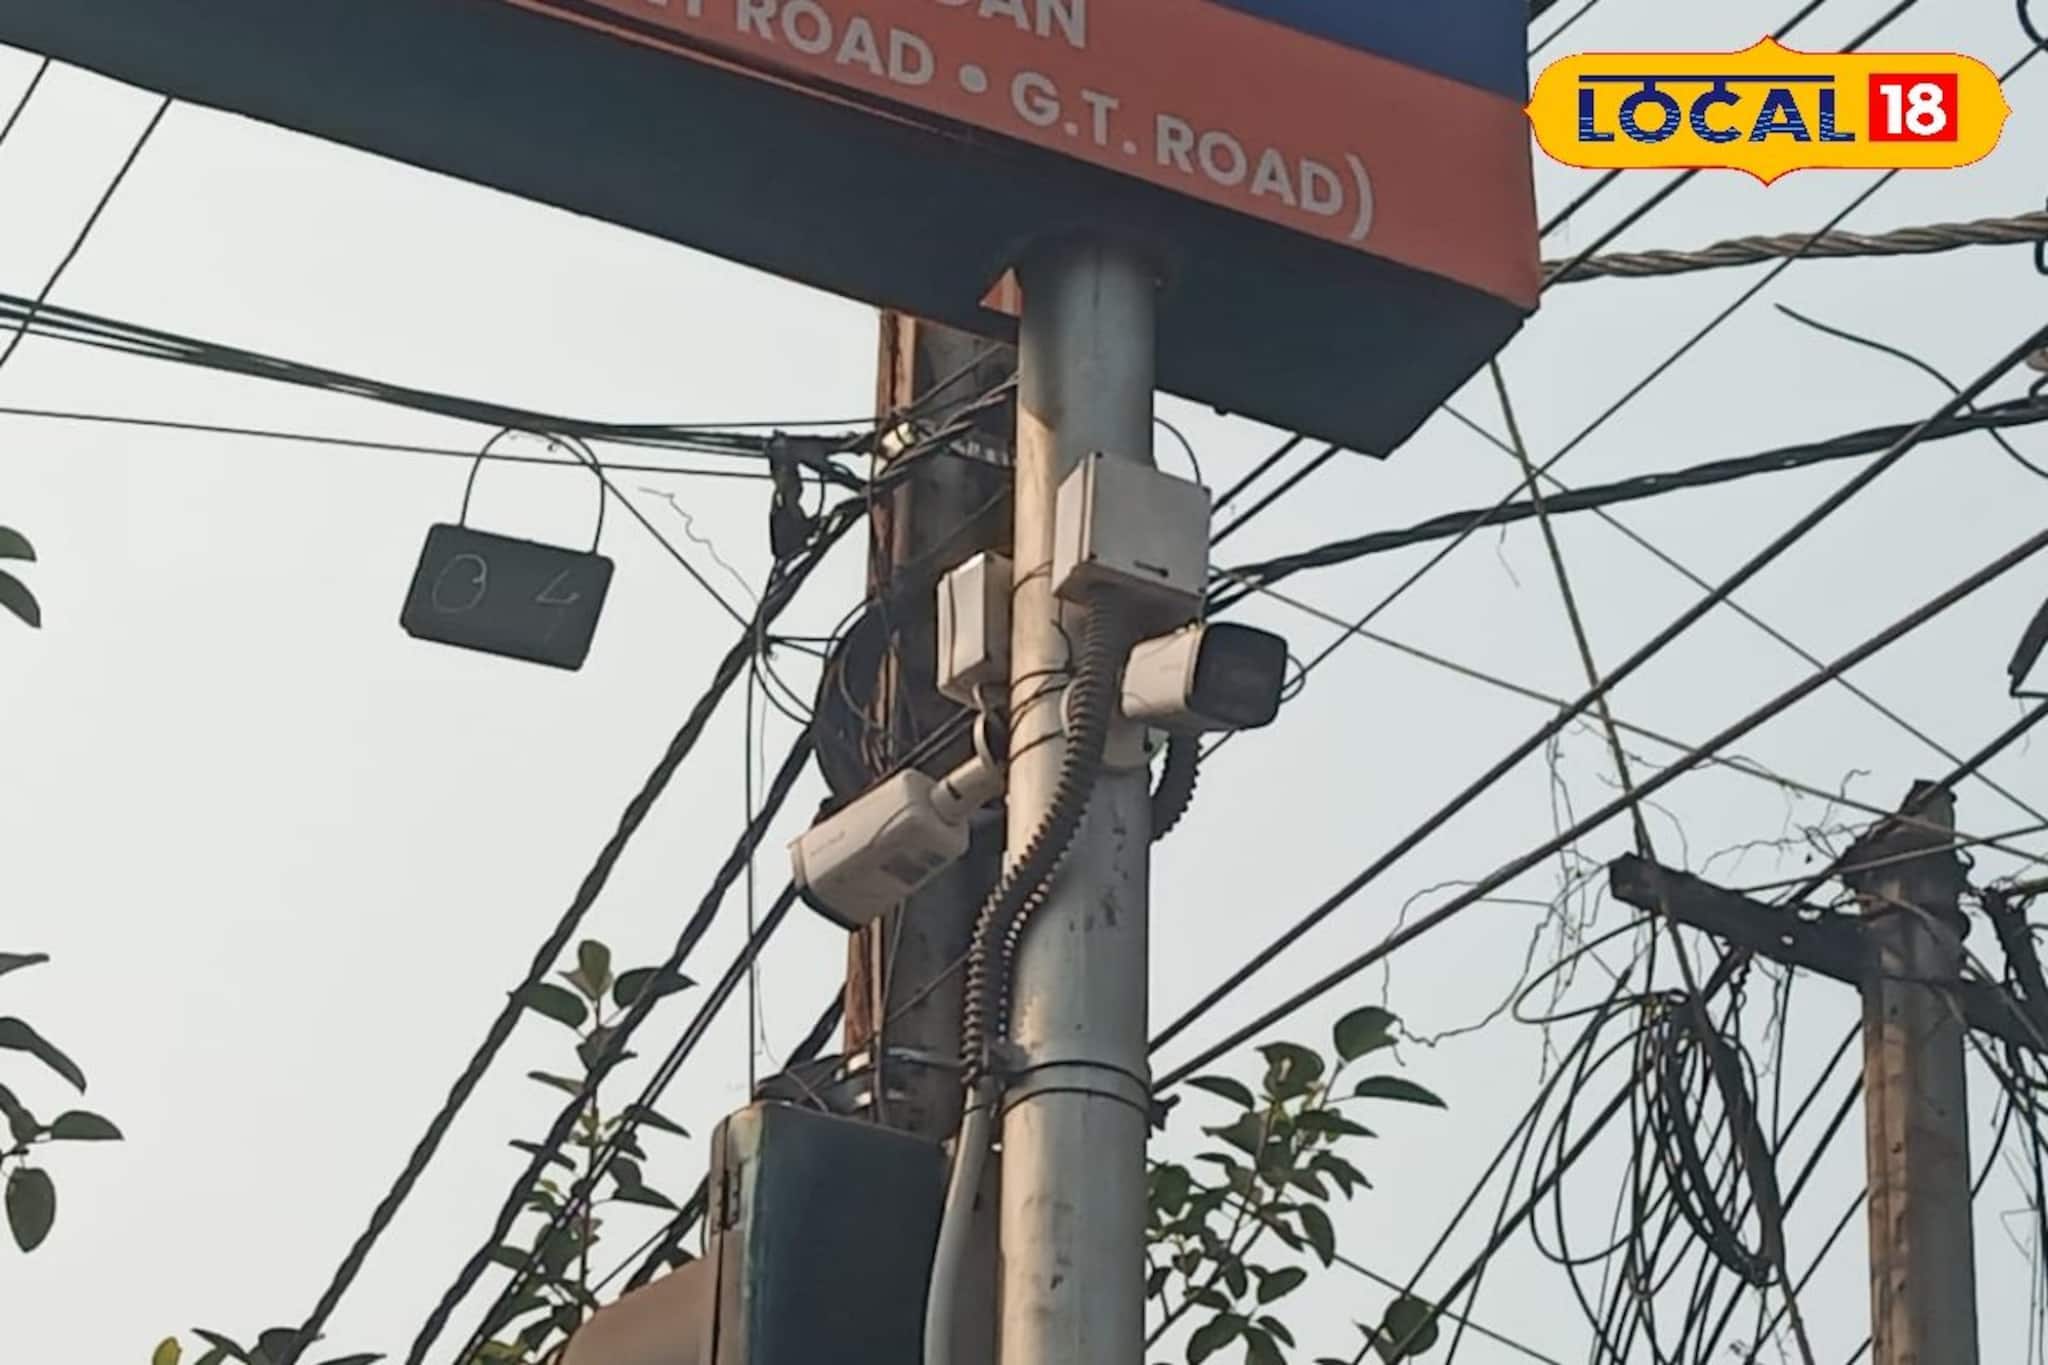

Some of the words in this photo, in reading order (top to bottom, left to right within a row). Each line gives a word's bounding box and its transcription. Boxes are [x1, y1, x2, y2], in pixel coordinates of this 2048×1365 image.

[934, 0, 1087, 48] AN
[736, 0, 936, 86] ROAD
[1011, 71, 1137, 156] G.T.
[1156, 113, 1374, 241] ROAD)
